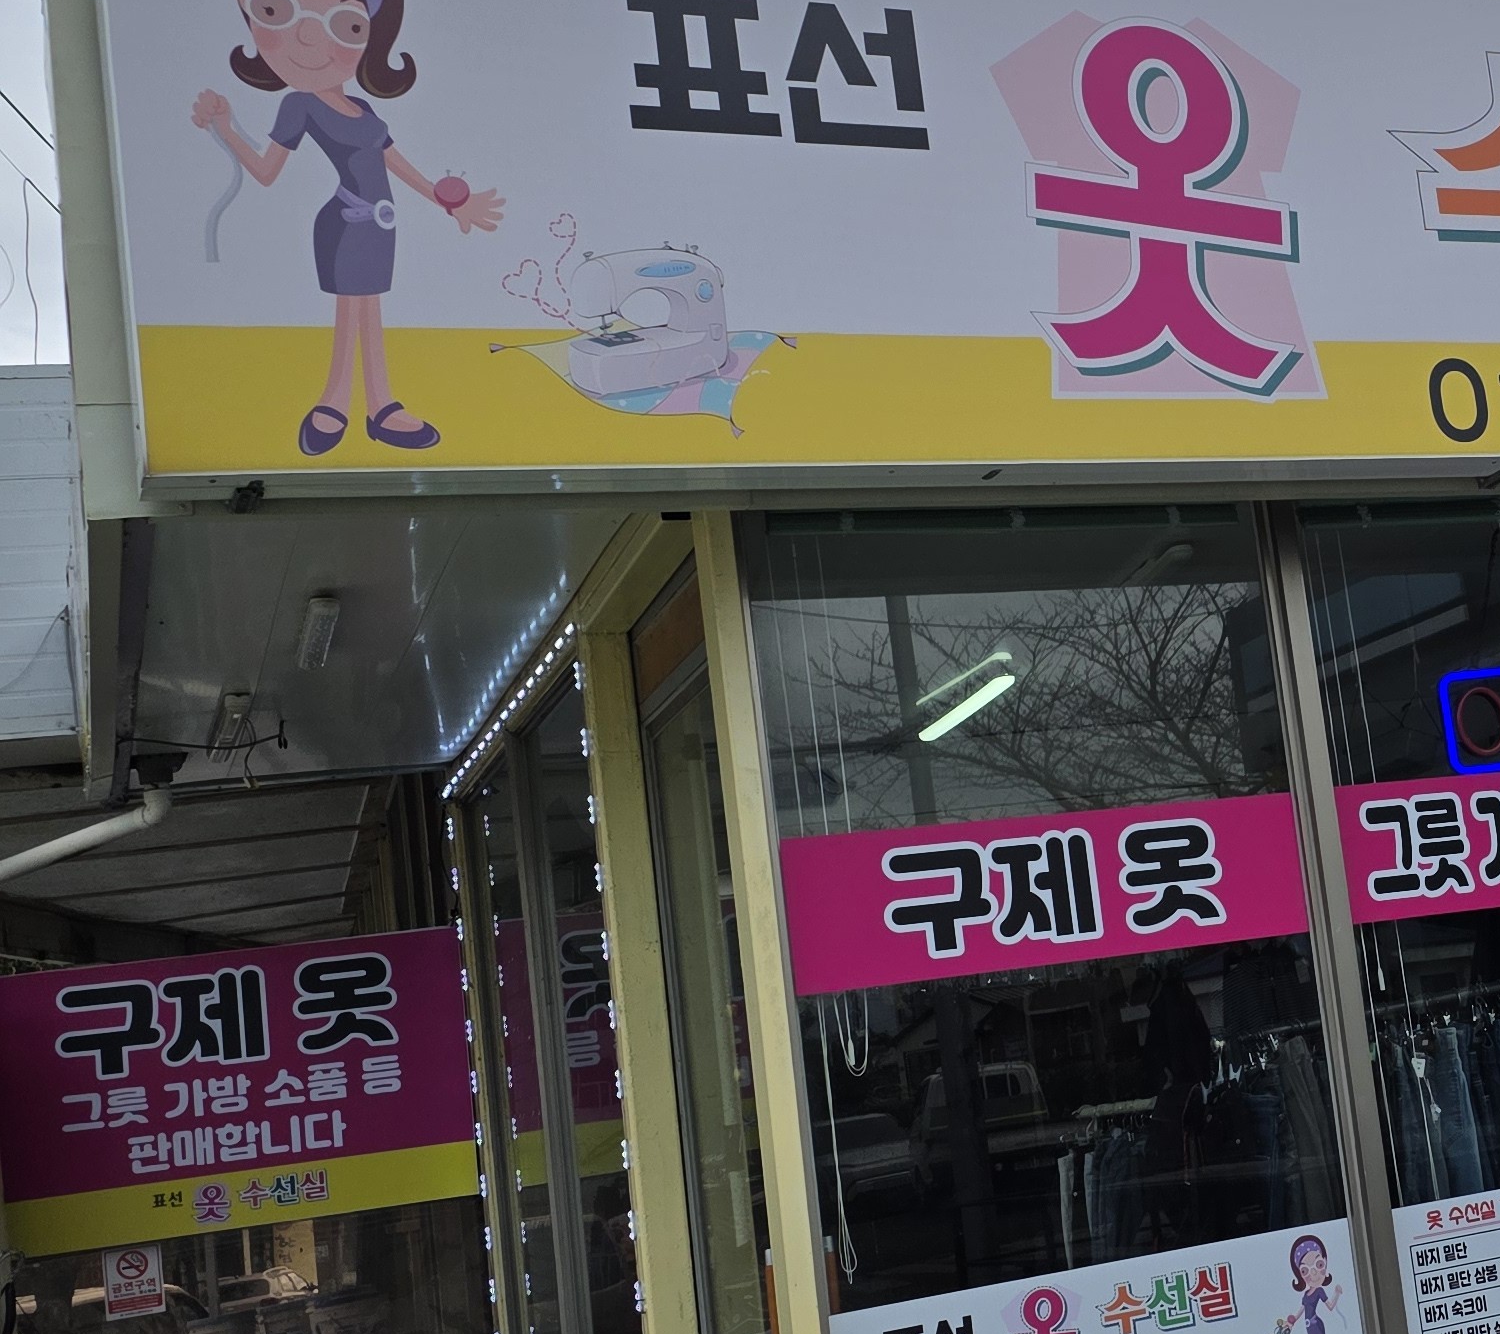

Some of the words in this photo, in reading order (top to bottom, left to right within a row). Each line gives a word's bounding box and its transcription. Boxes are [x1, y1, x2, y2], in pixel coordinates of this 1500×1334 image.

[1030, 19, 1298, 387] 옷
[1361, 791, 1472, 902] 그릇
[885, 828, 1103, 959] 구제
[1119, 818, 1226, 933] 옷
[57, 966, 268, 1080] 구제
[296, 953, 397, 1056] 옷
[61, 1086, 150, 1134] 그릇
[164, 1072, 251, 1120] 가방
[263, 1061, 348, 1107] 소품
[360, 1054, 402, 1097] 등
[127, 1110, 347, 1175] 판매합니다
[152, 1191, 183, 1208] 표선
[193, 1184, 231, 1221] 옷
[240, 1169, 329, 1209] 수선실
[1427, 1210, 1443, 1230] 옷
[1449, 1200, 1496, 1225] 수선실
[1416, 1247, 1441, 1267] 바지
[1443, 1242, 1468, 1261] 밑단
[1420, 1275, 1445, 1295] 바지
[1447, 1270, 1471, 1289] 밑단
[1474, 1264, 1498, 1285] 삼봉
[112, 1278, 156, 1294] 금연구역
[1424, 1303, 1449, 1323] 바지
[1451, 1295, 1488, 1317] 숙크이
